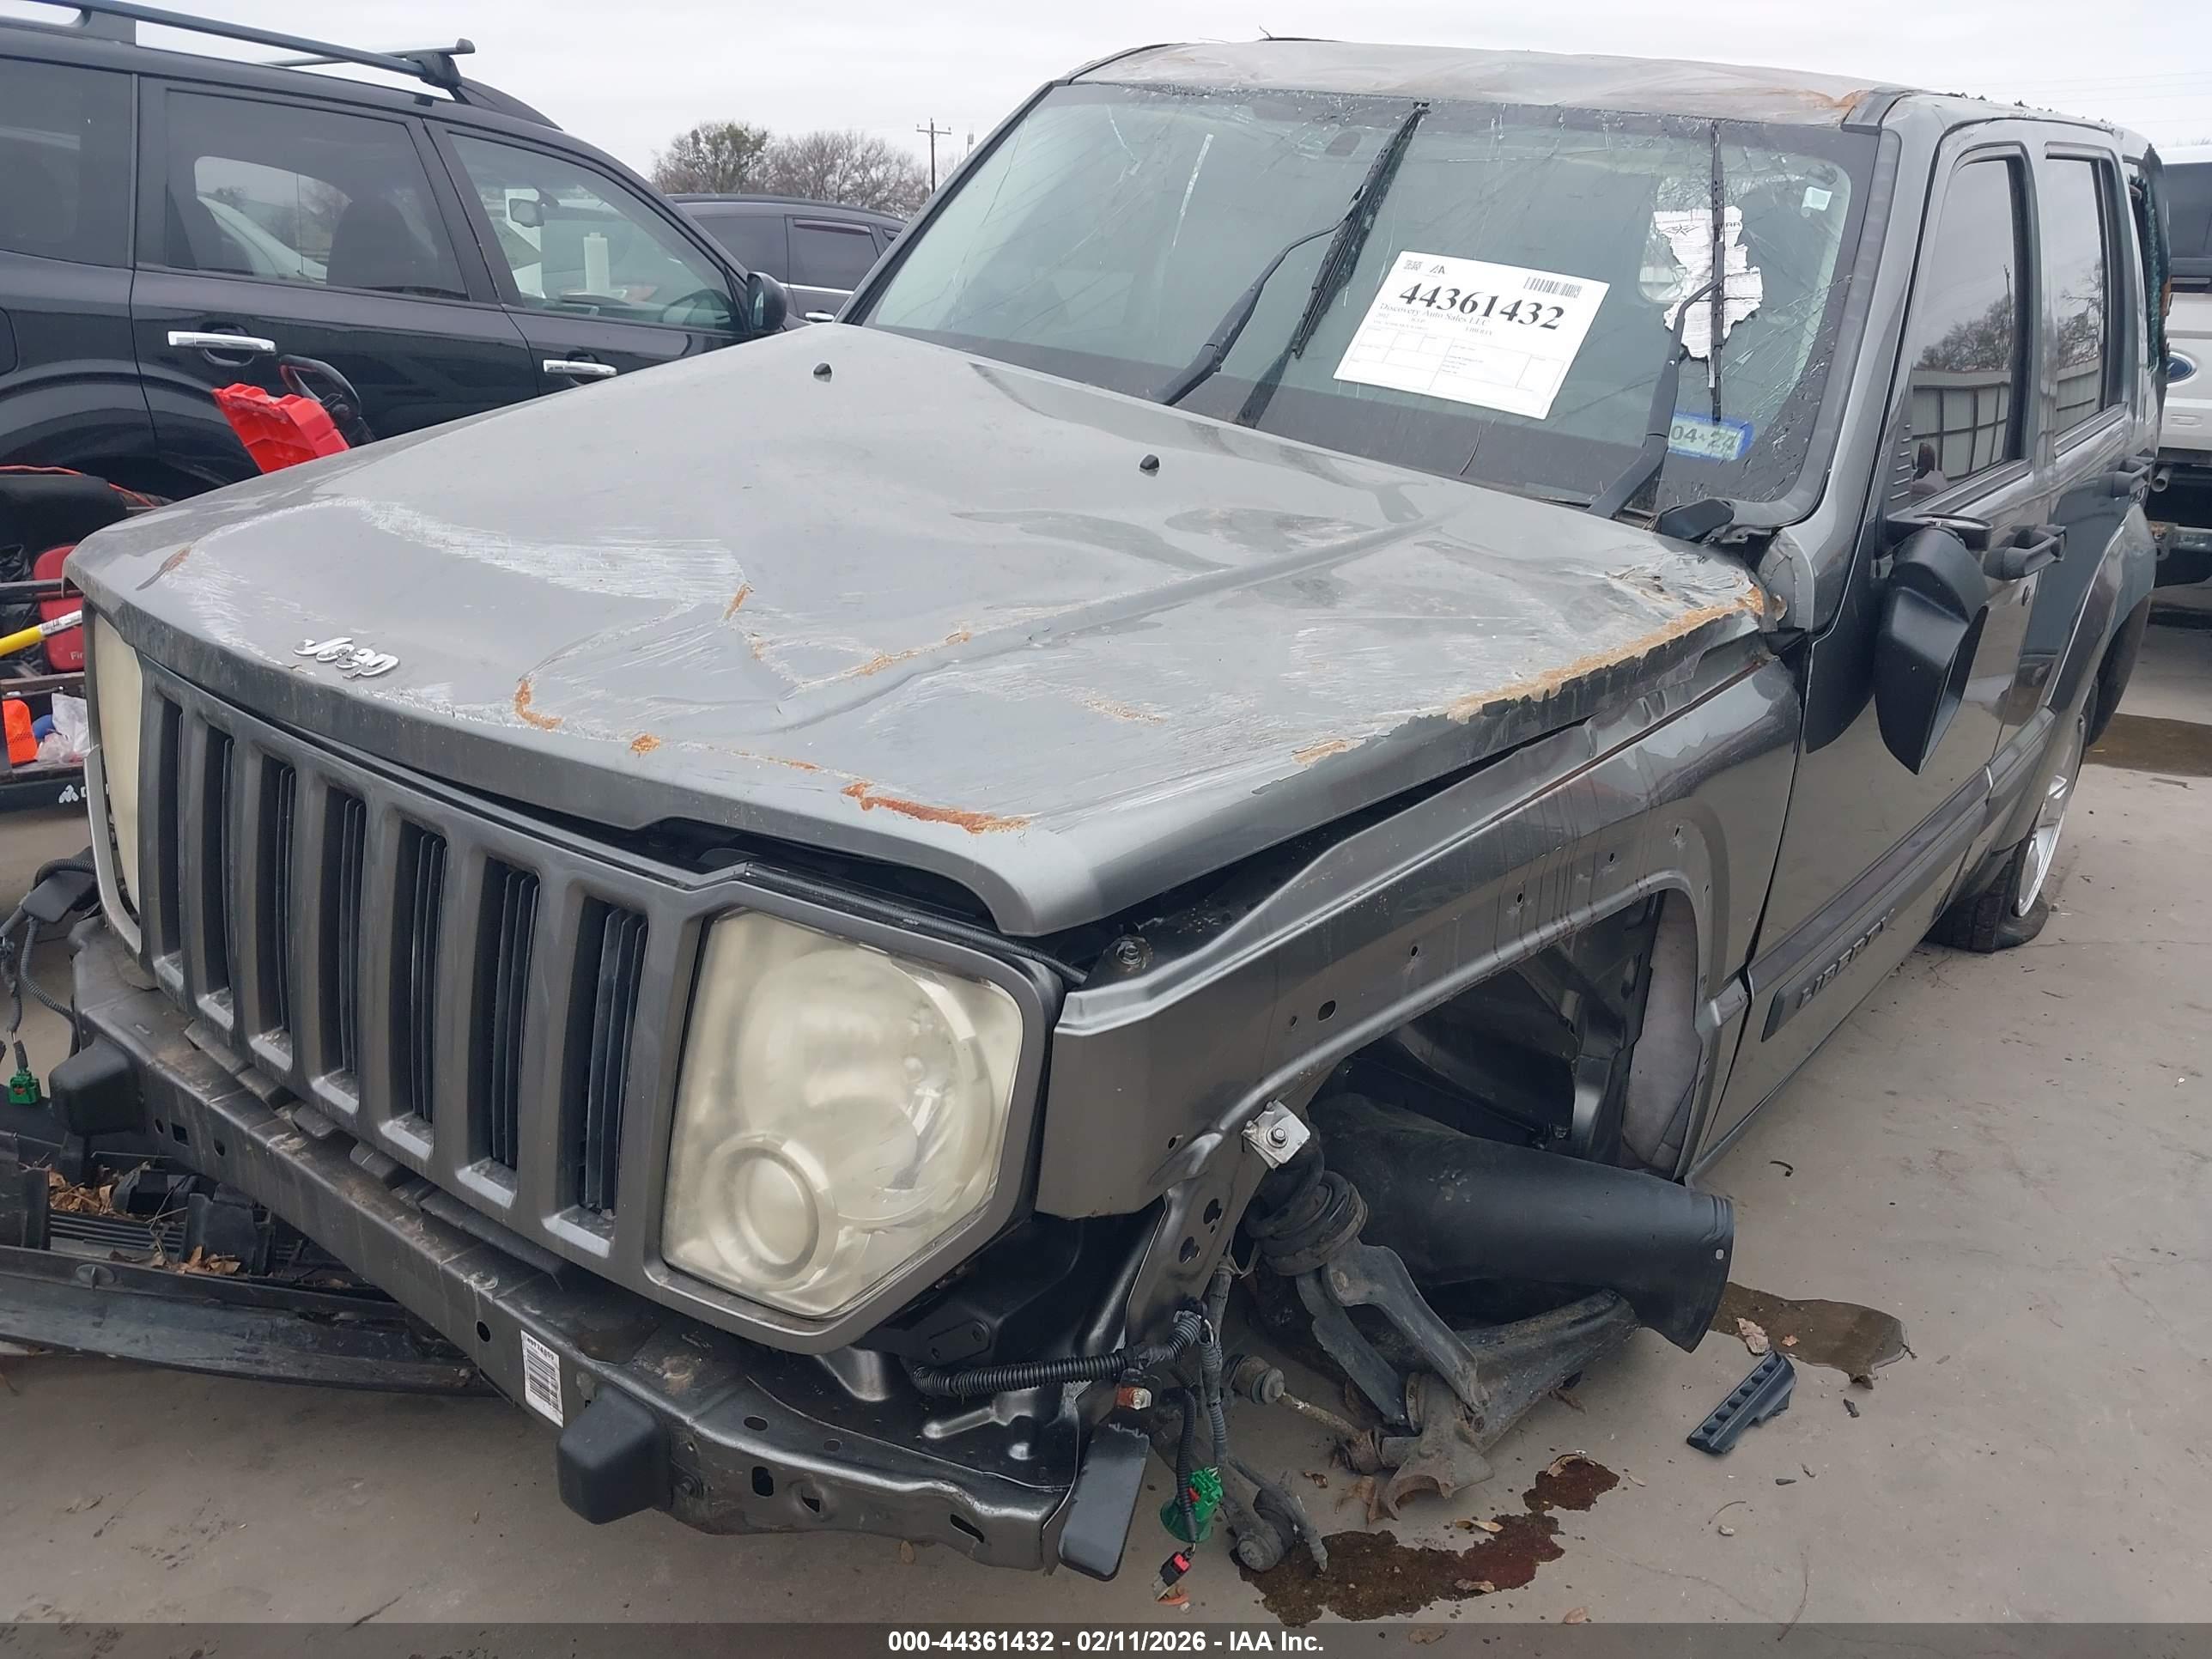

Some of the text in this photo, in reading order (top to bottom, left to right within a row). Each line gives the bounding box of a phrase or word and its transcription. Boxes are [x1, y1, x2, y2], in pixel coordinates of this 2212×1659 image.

[1380, 303, 1492, 326] Discovery Auto Sales LLC
[1399, 283, 1565, 331] 44361432
[293, 636, 400, 679] Jeep
